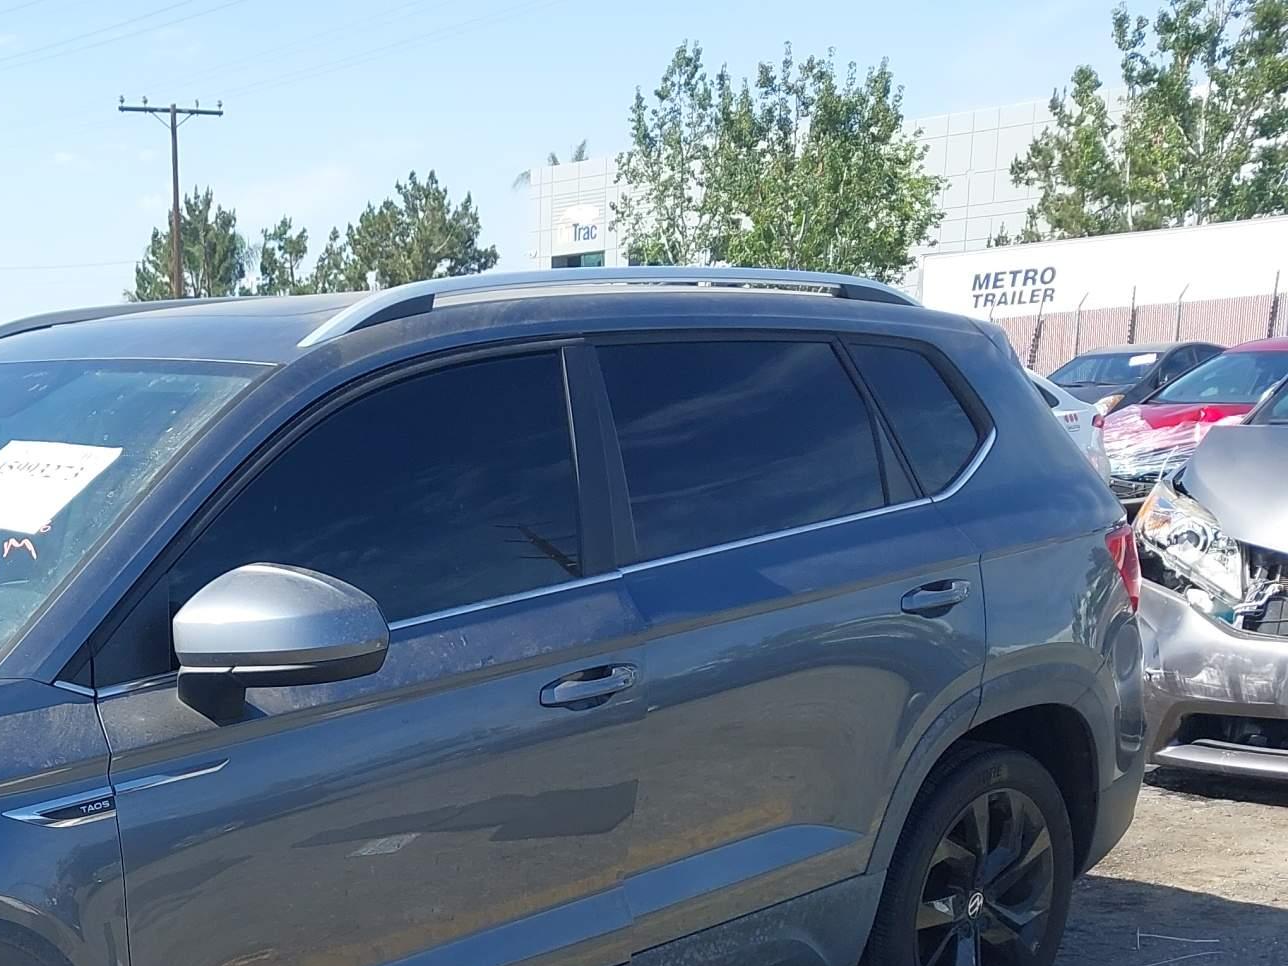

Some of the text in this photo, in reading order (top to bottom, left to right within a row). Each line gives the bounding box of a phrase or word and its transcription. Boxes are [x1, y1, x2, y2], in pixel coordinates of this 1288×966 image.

[972, 266, 1056, 291] METRO
[972, 288, 1055, 308] TRAILER
[80, 801, 110, 813] TAOS
